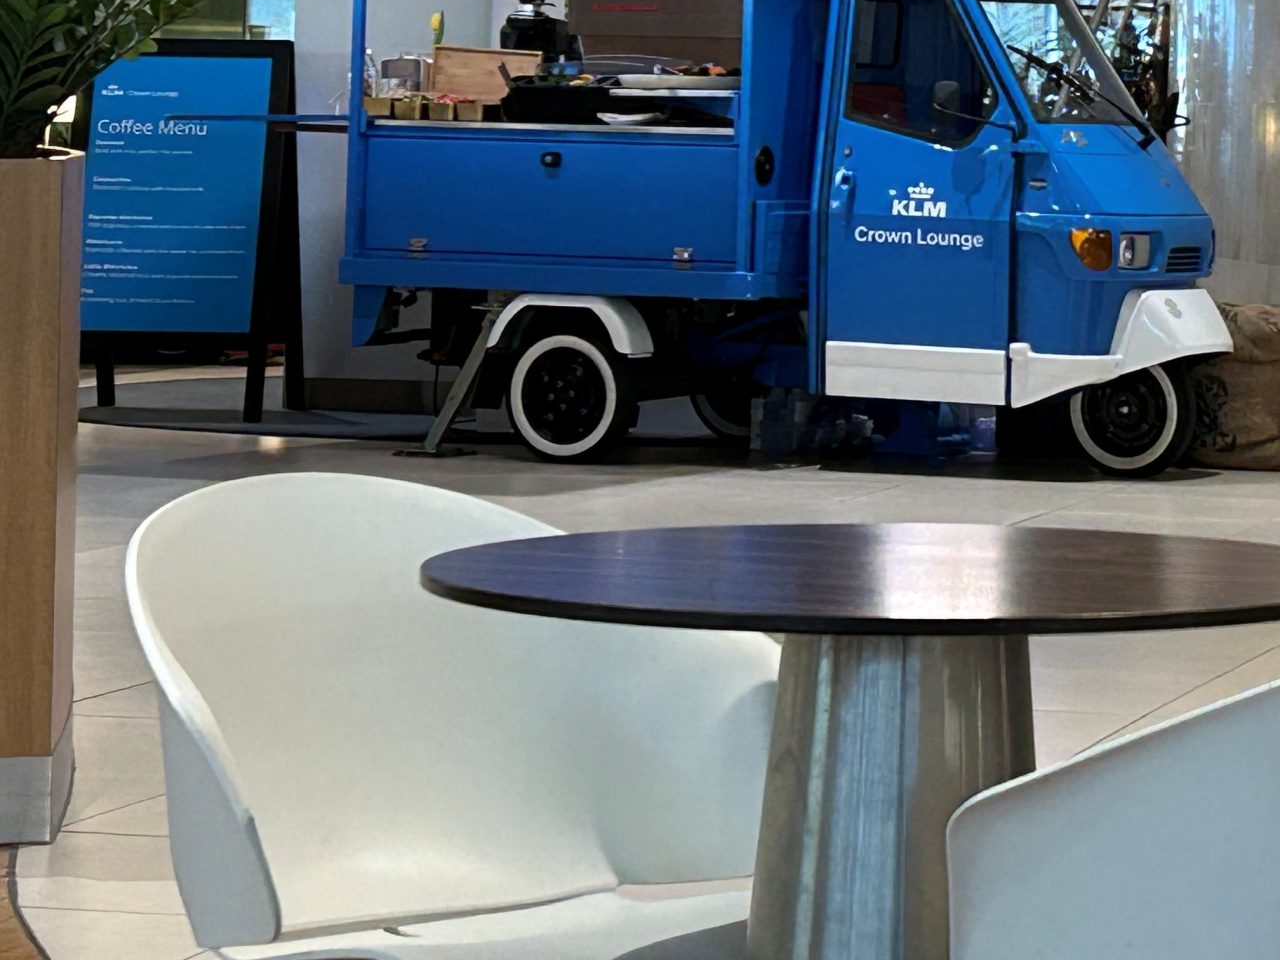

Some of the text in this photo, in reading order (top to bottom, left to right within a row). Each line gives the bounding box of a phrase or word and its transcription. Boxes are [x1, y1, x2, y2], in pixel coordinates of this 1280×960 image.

[97, 119, 208, 136] Coffee Menu
[892, 199, 947, 218] KLM
[854, 225, 984, 251] Crown Lounge
